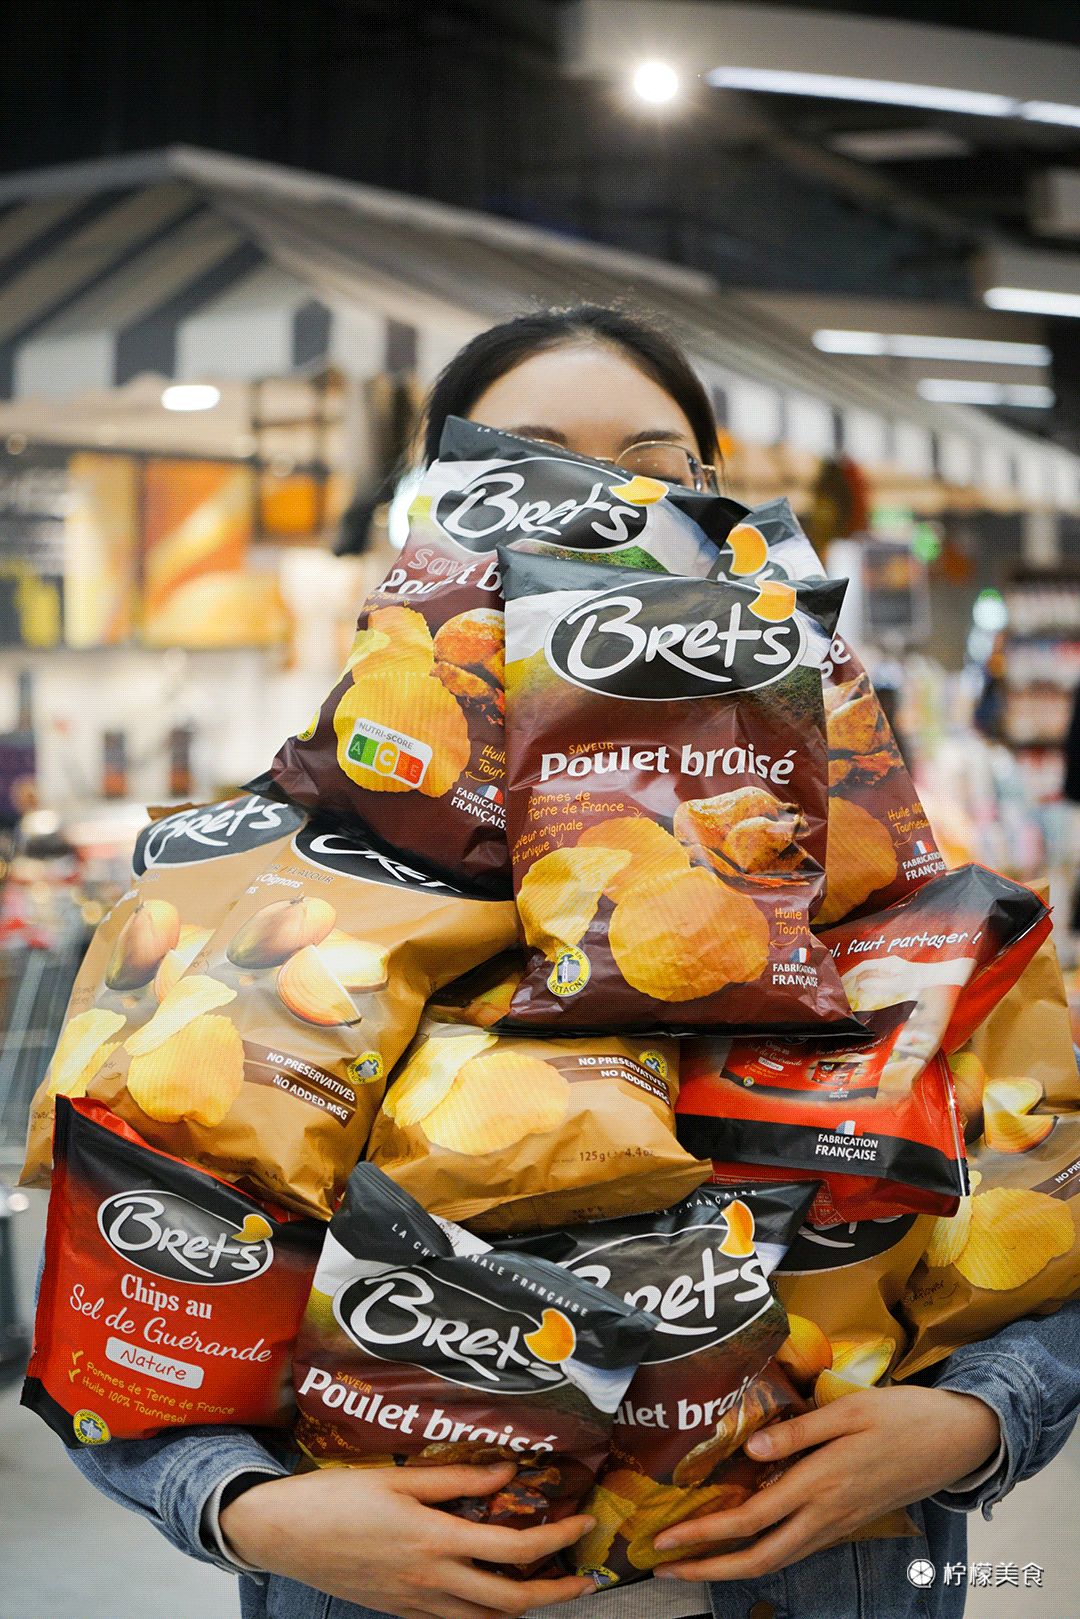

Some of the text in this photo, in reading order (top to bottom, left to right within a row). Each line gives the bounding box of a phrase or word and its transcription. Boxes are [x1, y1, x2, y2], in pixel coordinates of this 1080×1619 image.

[567, 596, 792, 682] Brets
[358, 722, 414, 750] NUTRI-SCORE
[569, 742, 614, 755] SAVEUR
[540, 742, 797, 785] Poulet braisé
[456, 787, 506, 817] FABRICATI
[575, 790, 591, 801] de
[451, 796, 506, 831] FRANÇAIS
[528, 801, 625, 821] Terre de France
[539, 819, 583, 837] originale
[892, 819, 929, 834] Tourneso
[902, 851, 942, 870] FABRICATIO
[774, 907, 802, 920] Huile
[846, 935, 886, 955] faut
[887, 931, 968, 953] partager
[578, 1058, 596, 1066] NO
[266, 1052, 284, 1064] NO
[285, 1058, 356, 1102] PRESERVATIVES
[600, 1069, 619, 1077] NO
[620, 1072, 652, 1092] ADDED
[272, 1074, 349, 1120] NO ADDED MSG
[815, 1145, 877, 1161] FRANÇAISE
[818, 1134, 879, 1149] FABRICATION
[1055, 1172, 1069, 1183] NO
[109, 1196, 262, 1278] Brets
[391, 1223, 408, 1239] LA
[511, 1274, 589, 1318] FRANÇAISE
[120, 1273, 213, 1320] Chips au
[69, 1284, 272, 1363] Sel de Guérande
[120, 1347, 188, 1382] Nature
[86, 1361, 236, 1415] Pommes de Terre de France
[335, 1371, 373, 1394] SAVEUR
[82, 1376, 188, 1425] Huile 100% Tournesol
[298, 1366, 420, 1435] Poulet
[613, 1398, 669, 1430] ulet
